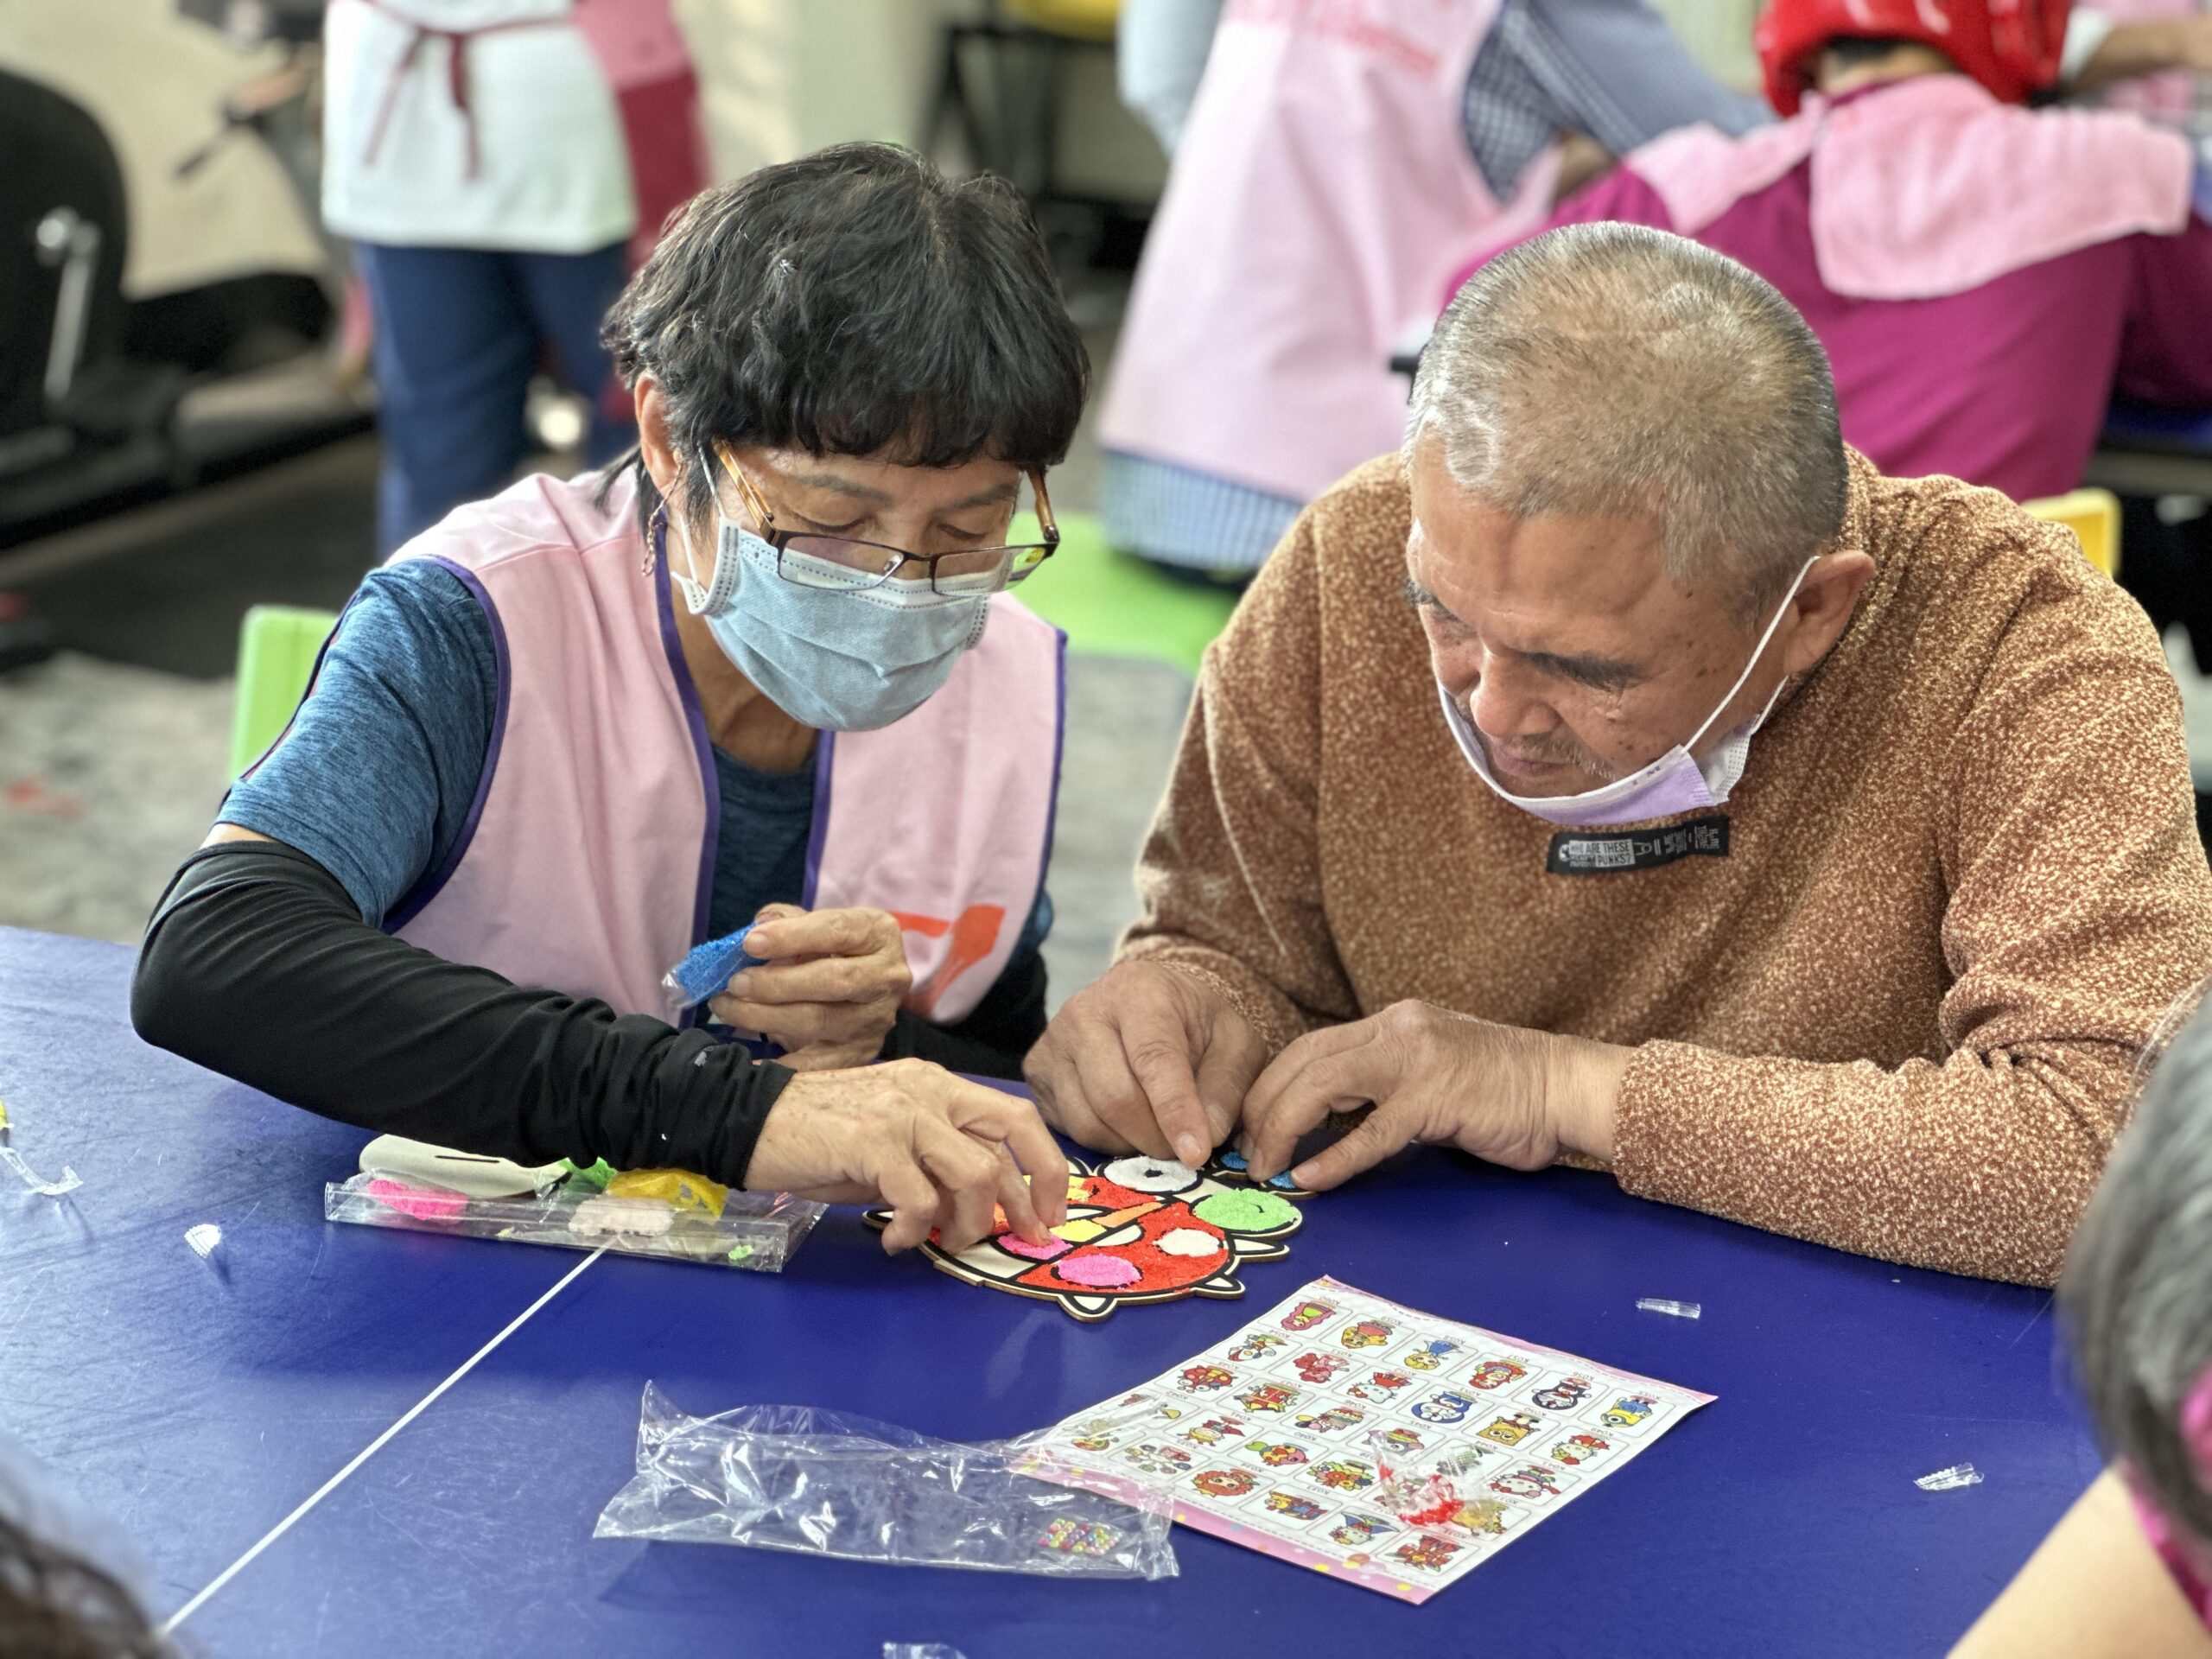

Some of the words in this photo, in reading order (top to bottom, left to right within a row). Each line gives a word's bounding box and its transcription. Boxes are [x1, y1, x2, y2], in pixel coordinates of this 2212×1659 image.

[1586, 842, 1602, 854] ARE
[1603, 842, 1630, 854] THESE
[1598, 854, 1632, 866] PUNKS?
[1442, 1335, 1465, 1344] K058
[1507, 1354, 1529, 1363] K057
